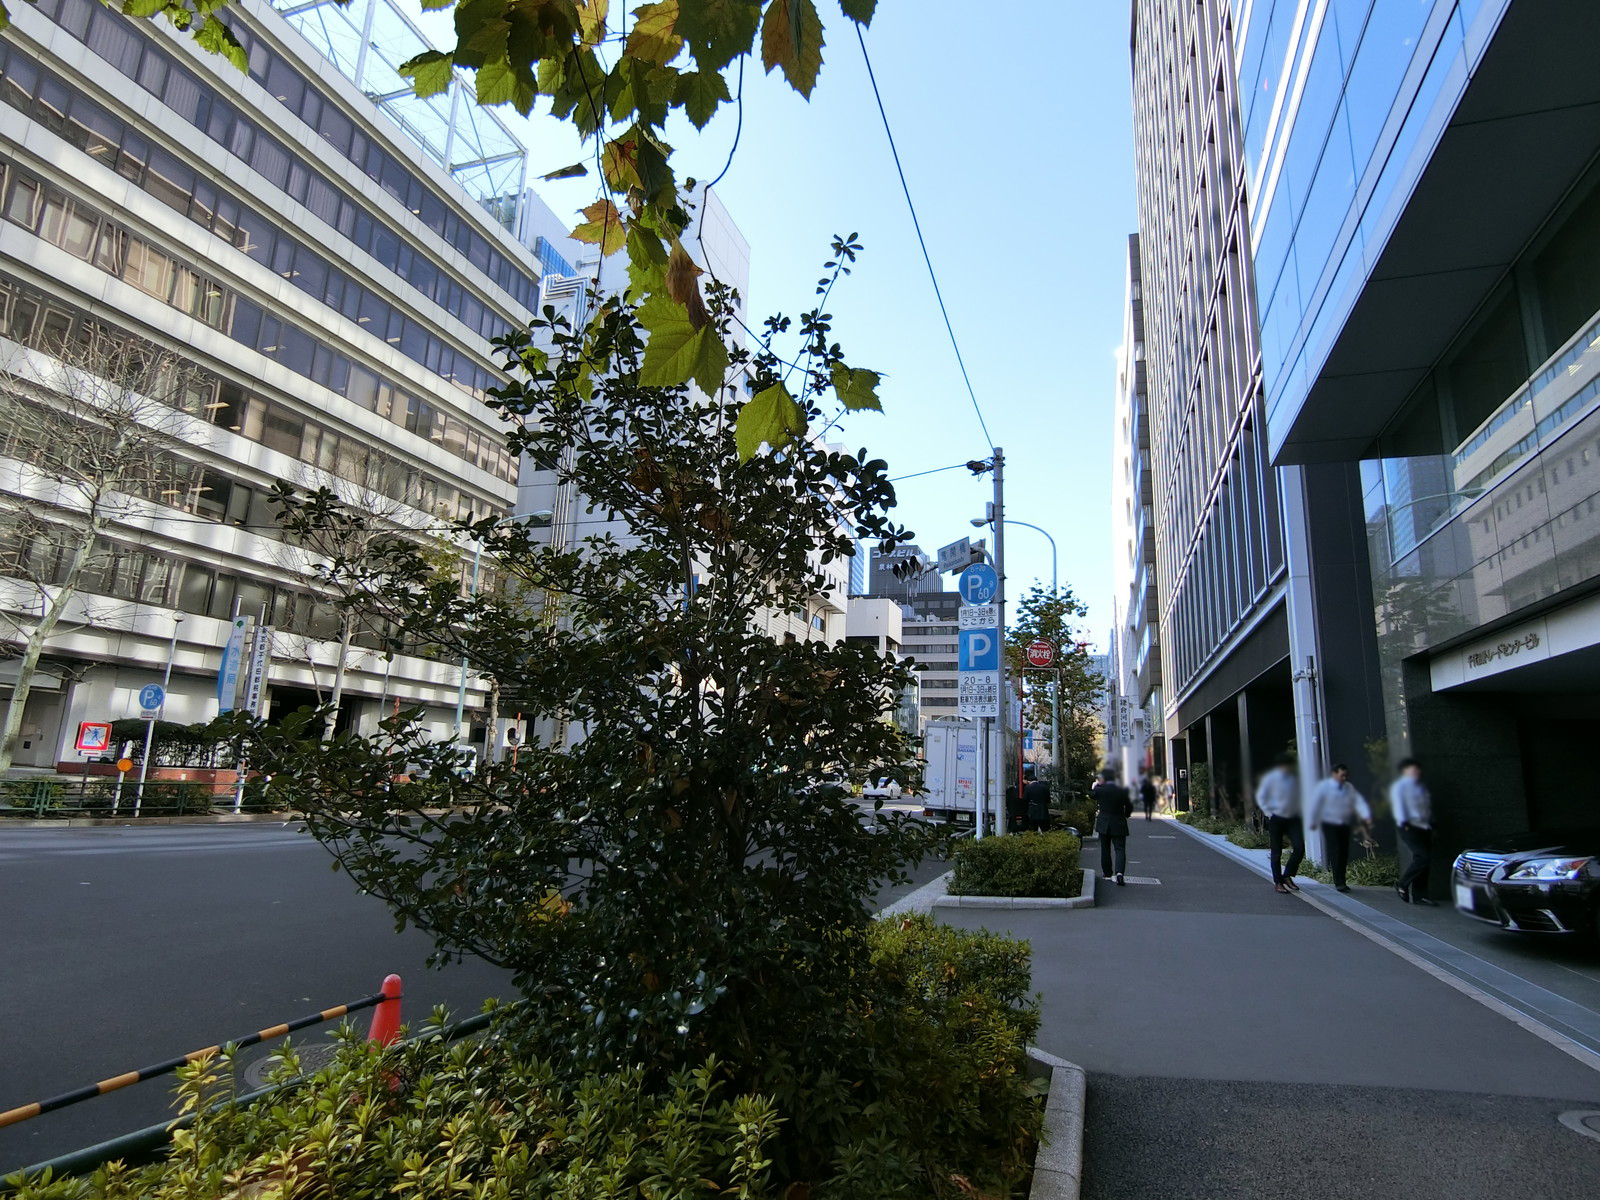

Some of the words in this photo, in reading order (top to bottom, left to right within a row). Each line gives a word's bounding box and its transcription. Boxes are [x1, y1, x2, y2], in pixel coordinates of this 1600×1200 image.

[967, 574, 983, 601] P
[977, 587, 990, 600] 60
[961, 616, 996, 626] ここから
[968, 633, 992, 668] P
[1029, 649, 1051, 660] 消火栓
[143, 689, 155, 706] P
[961, 704, 997, 713] ここから
